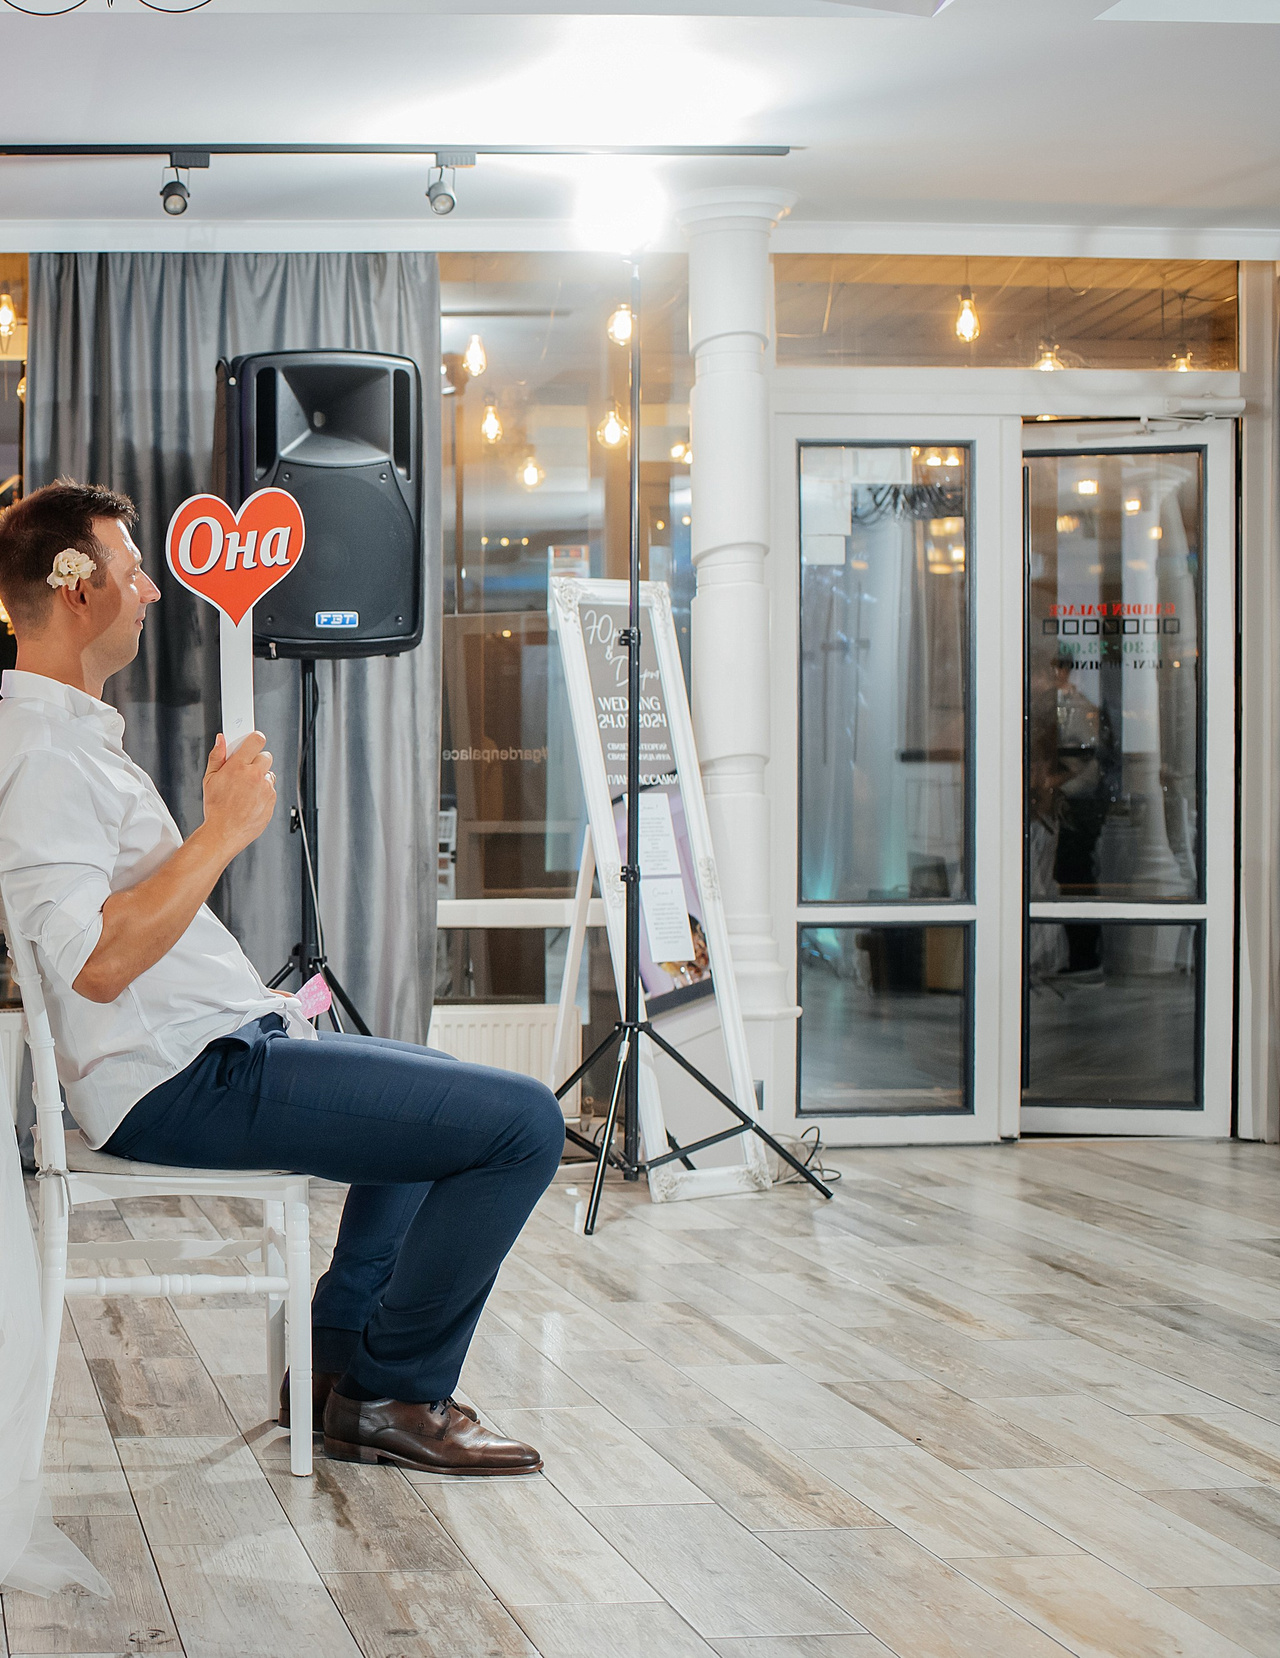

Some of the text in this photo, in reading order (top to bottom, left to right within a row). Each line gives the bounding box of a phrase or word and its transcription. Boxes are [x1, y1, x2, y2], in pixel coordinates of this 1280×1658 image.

[178, 516, 292, 576] Она
[320, 614, 355, 625] FBT
[597, 696, 661, 711] WEDING
[597, 713, 667, 729] 24.02024
[638, 774, 680, 785] АССАДКИ
